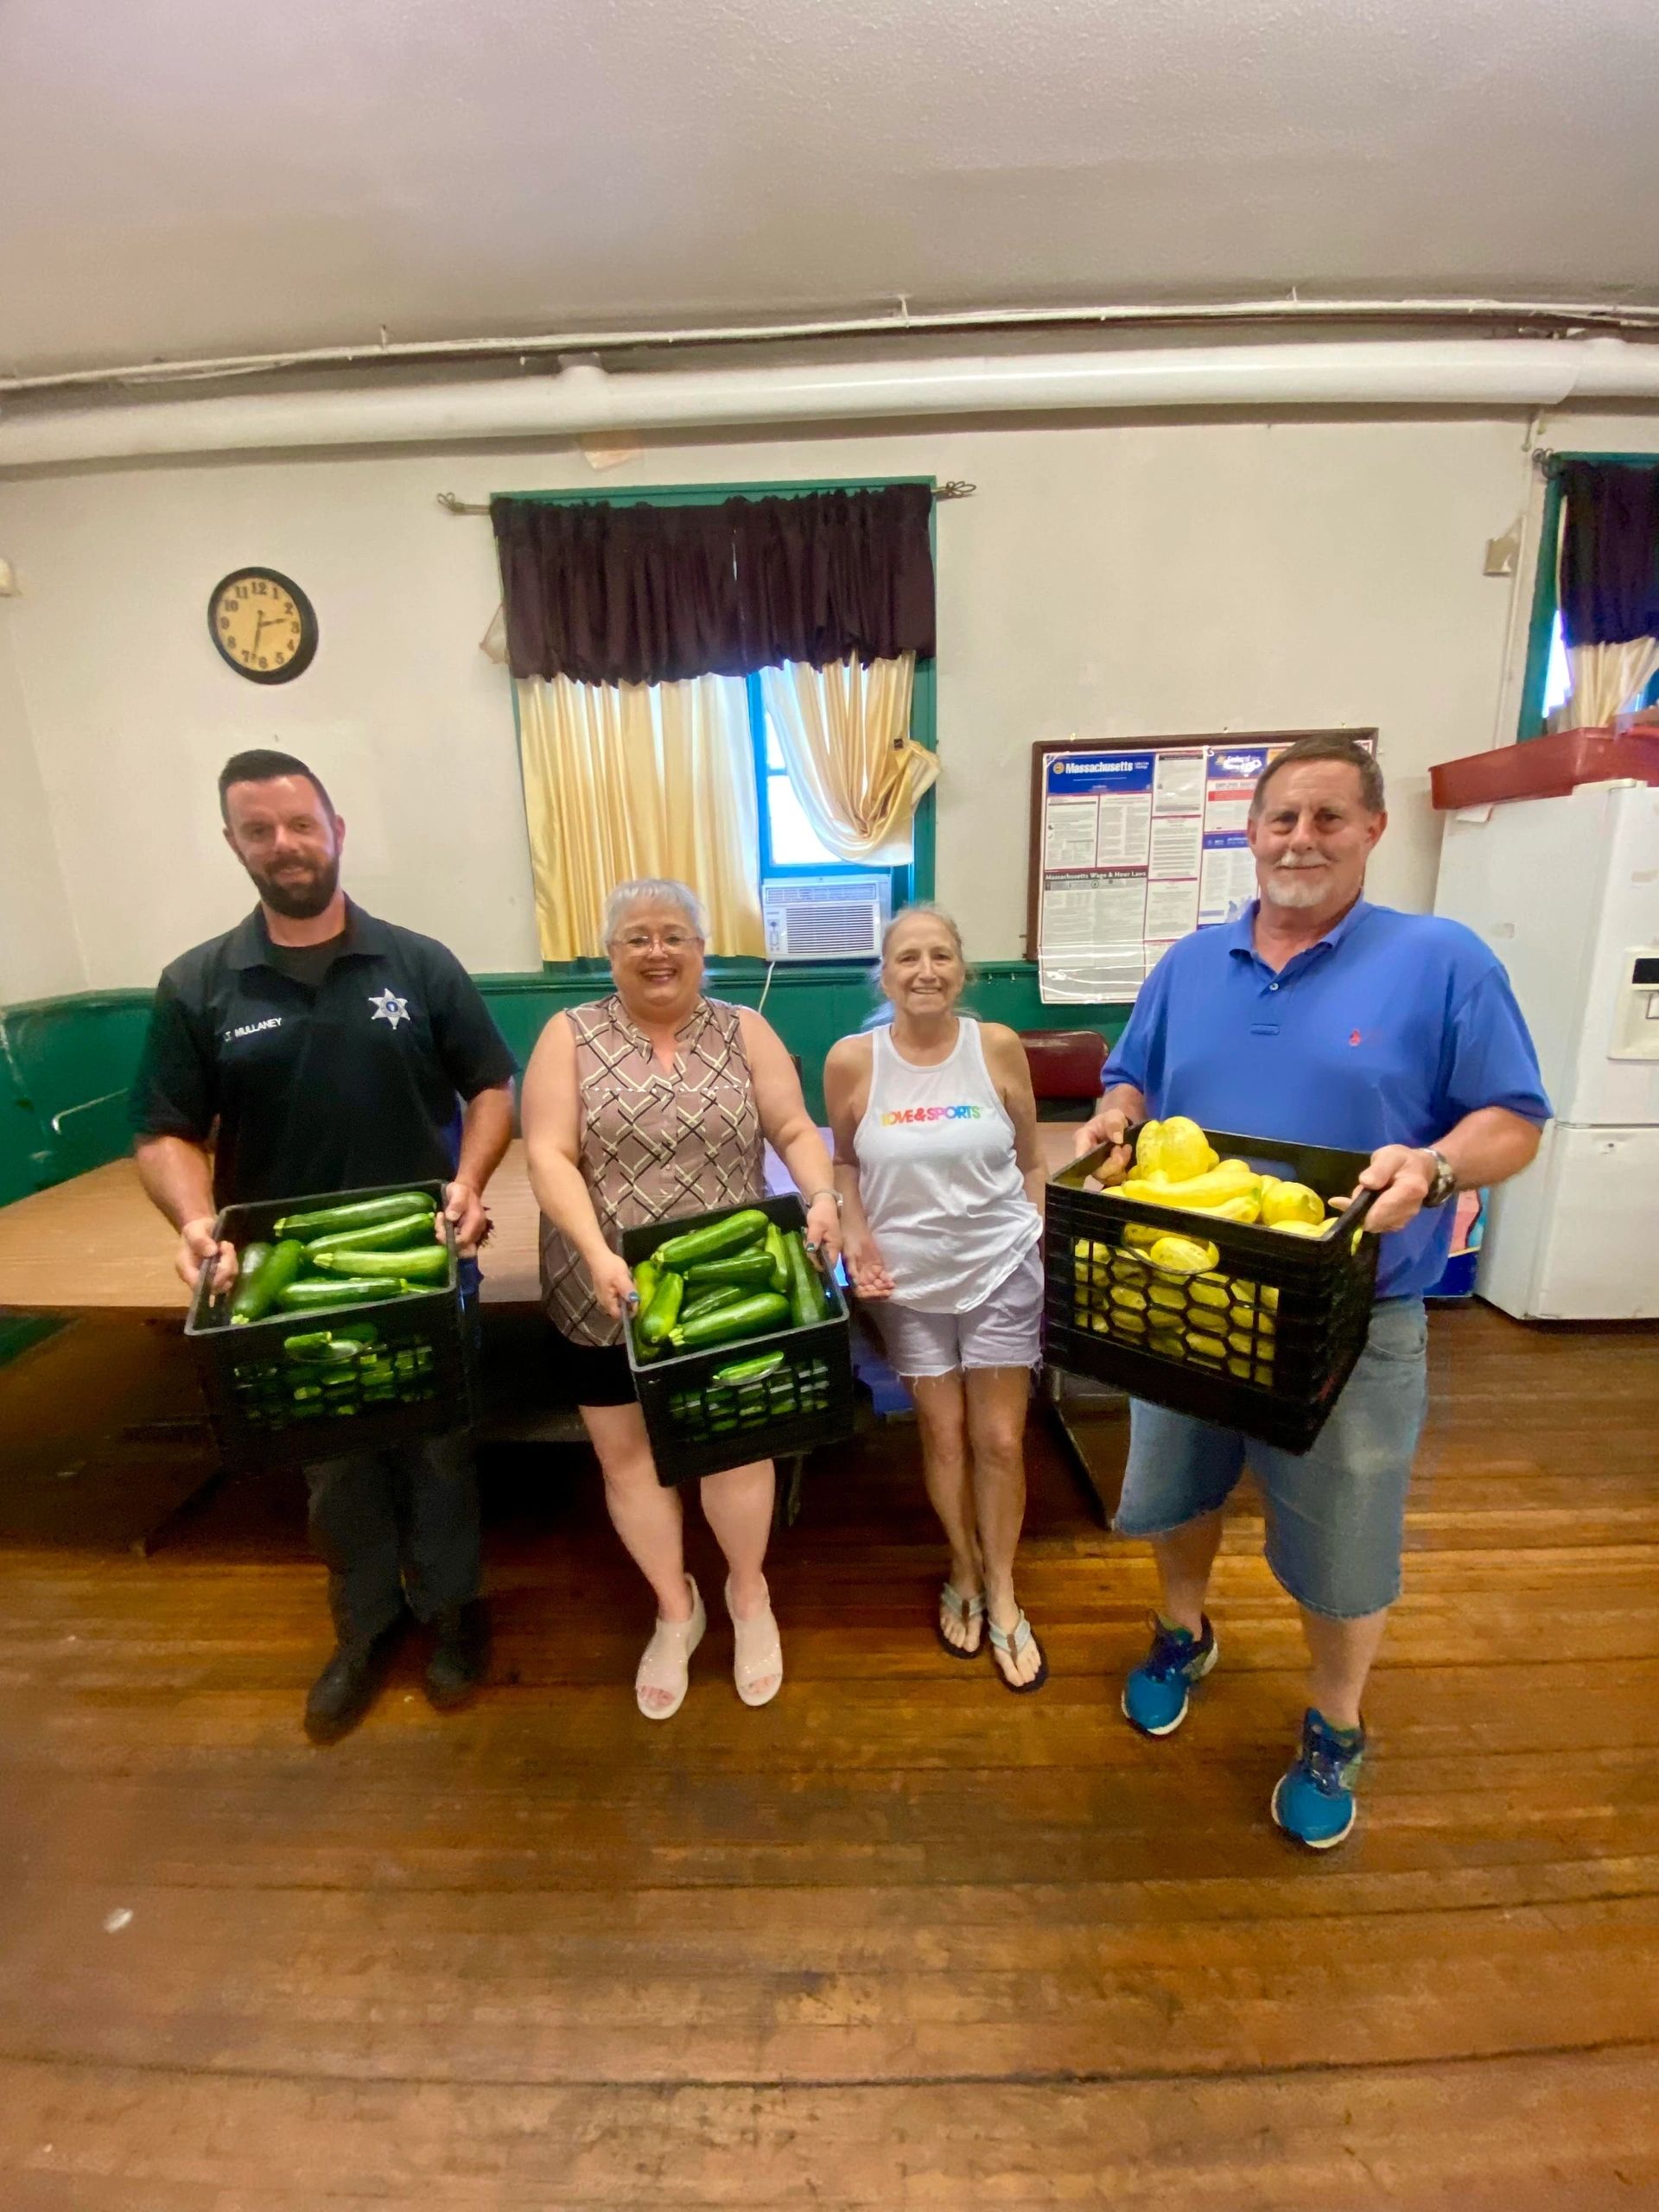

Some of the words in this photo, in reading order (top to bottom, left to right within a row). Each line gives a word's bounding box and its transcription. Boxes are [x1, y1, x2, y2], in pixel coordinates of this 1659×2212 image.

[236, 587, 248, 599] 11
[251, 582, 267, 594] 12
[273, 587, 278, 599] 1
[225, 600, 238, 612] 10
[284, 602, 293, 615] 2
[220, 617, 230, 629] 9
[291, 621, 300, 633] 3
[227, 636, 236, 649] 8
[288, 639, 295, 652] 4
[242, 650, 249, 663] 7
[258, 657, 268, 668] 6
[276, 652, 284, 664] 5
[1065, 761, 1134, 774] Massachusetts
[234, 1018, 282, 1038] MULLANEY
